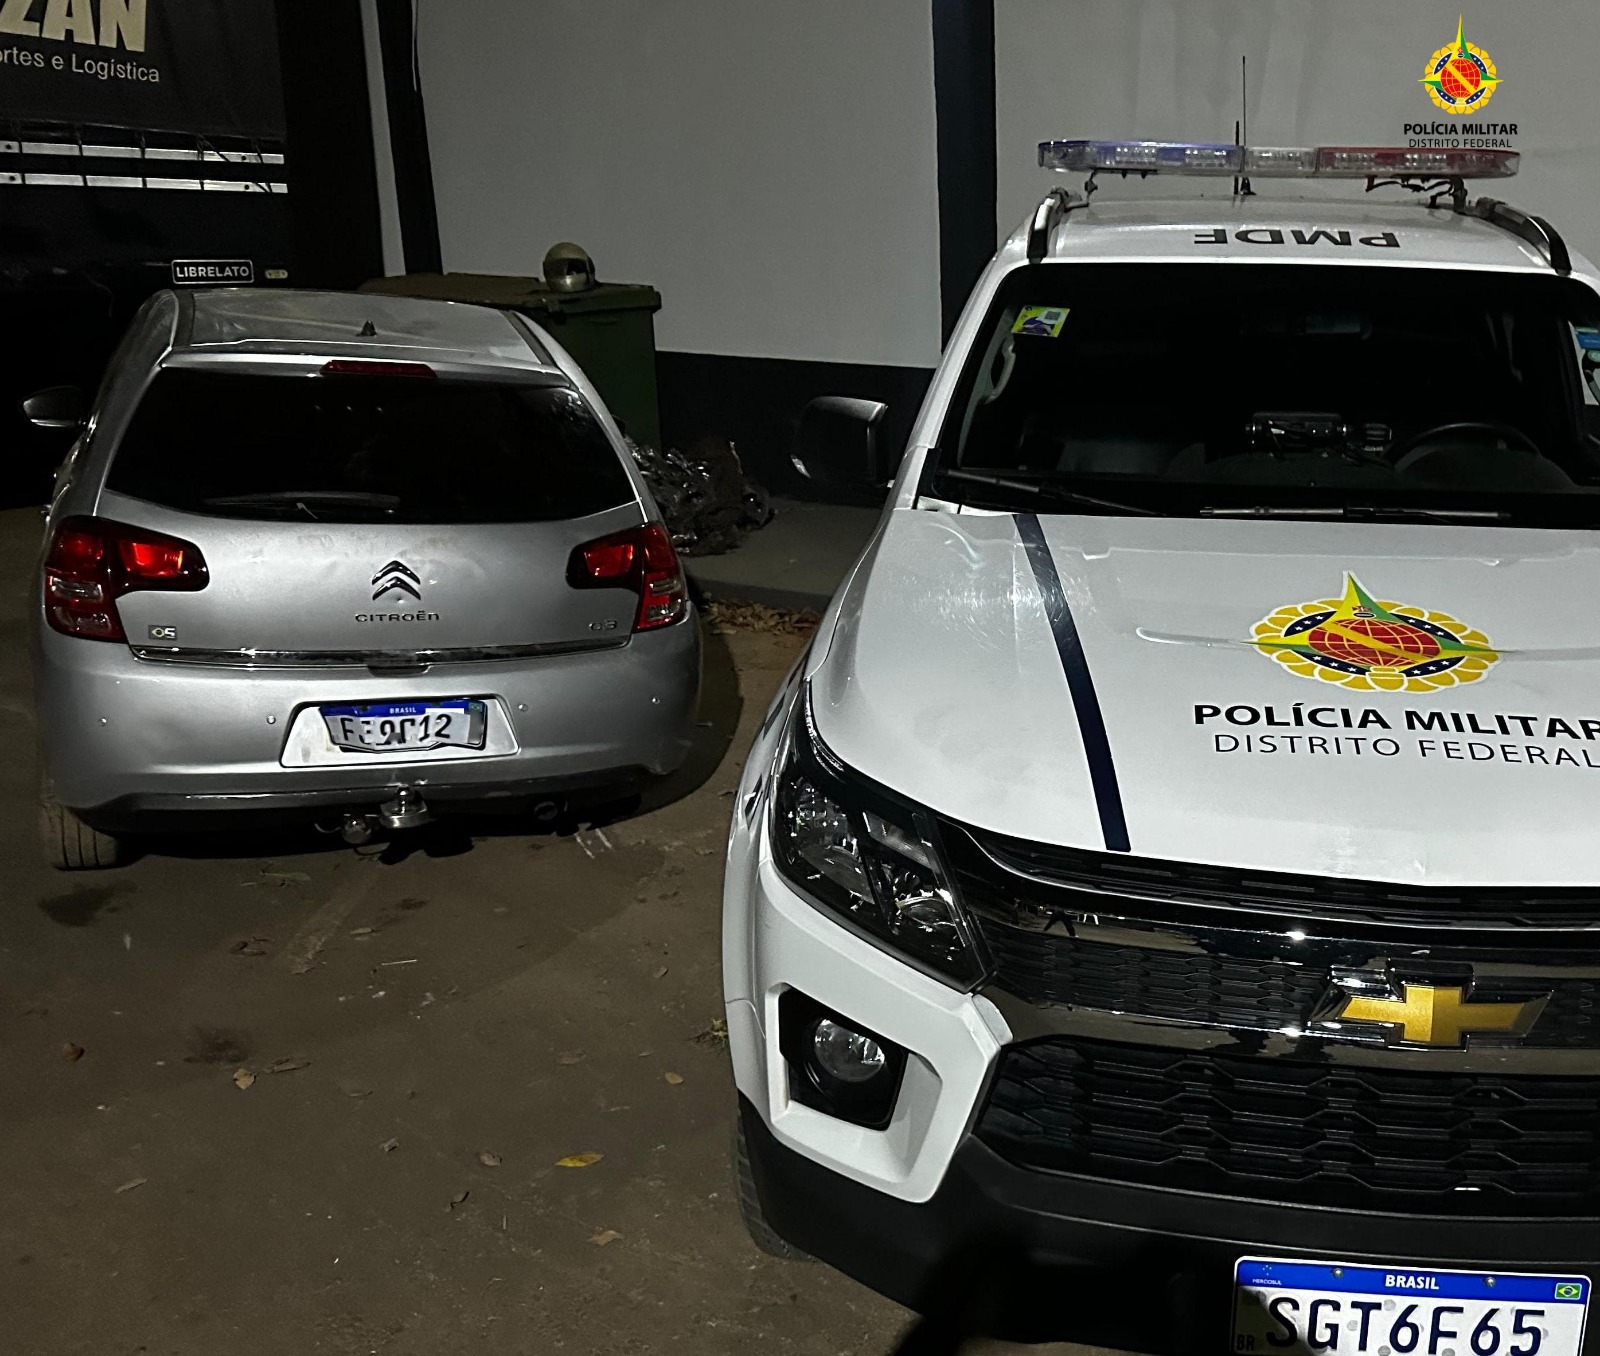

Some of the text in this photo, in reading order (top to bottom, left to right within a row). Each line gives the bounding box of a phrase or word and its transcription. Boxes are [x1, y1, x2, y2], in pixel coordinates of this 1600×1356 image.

[0, 47, 160, 82] rtes e Logística
[1194, 228, 1401, 248] PMDF
[176, 266, 250, 277] LIBRELATO
[1194, 702, 1600, 741] POLÍCIA MILITAR
[1213, 734, 1600, 768] DISTRITO FEDERAL
[1252, 1278, 1282, 1286] MERCOSUL
[1385, 1274, 1440, 1290] BRASIL
[1265, 1296, 1546, 1356] SGT6F65
